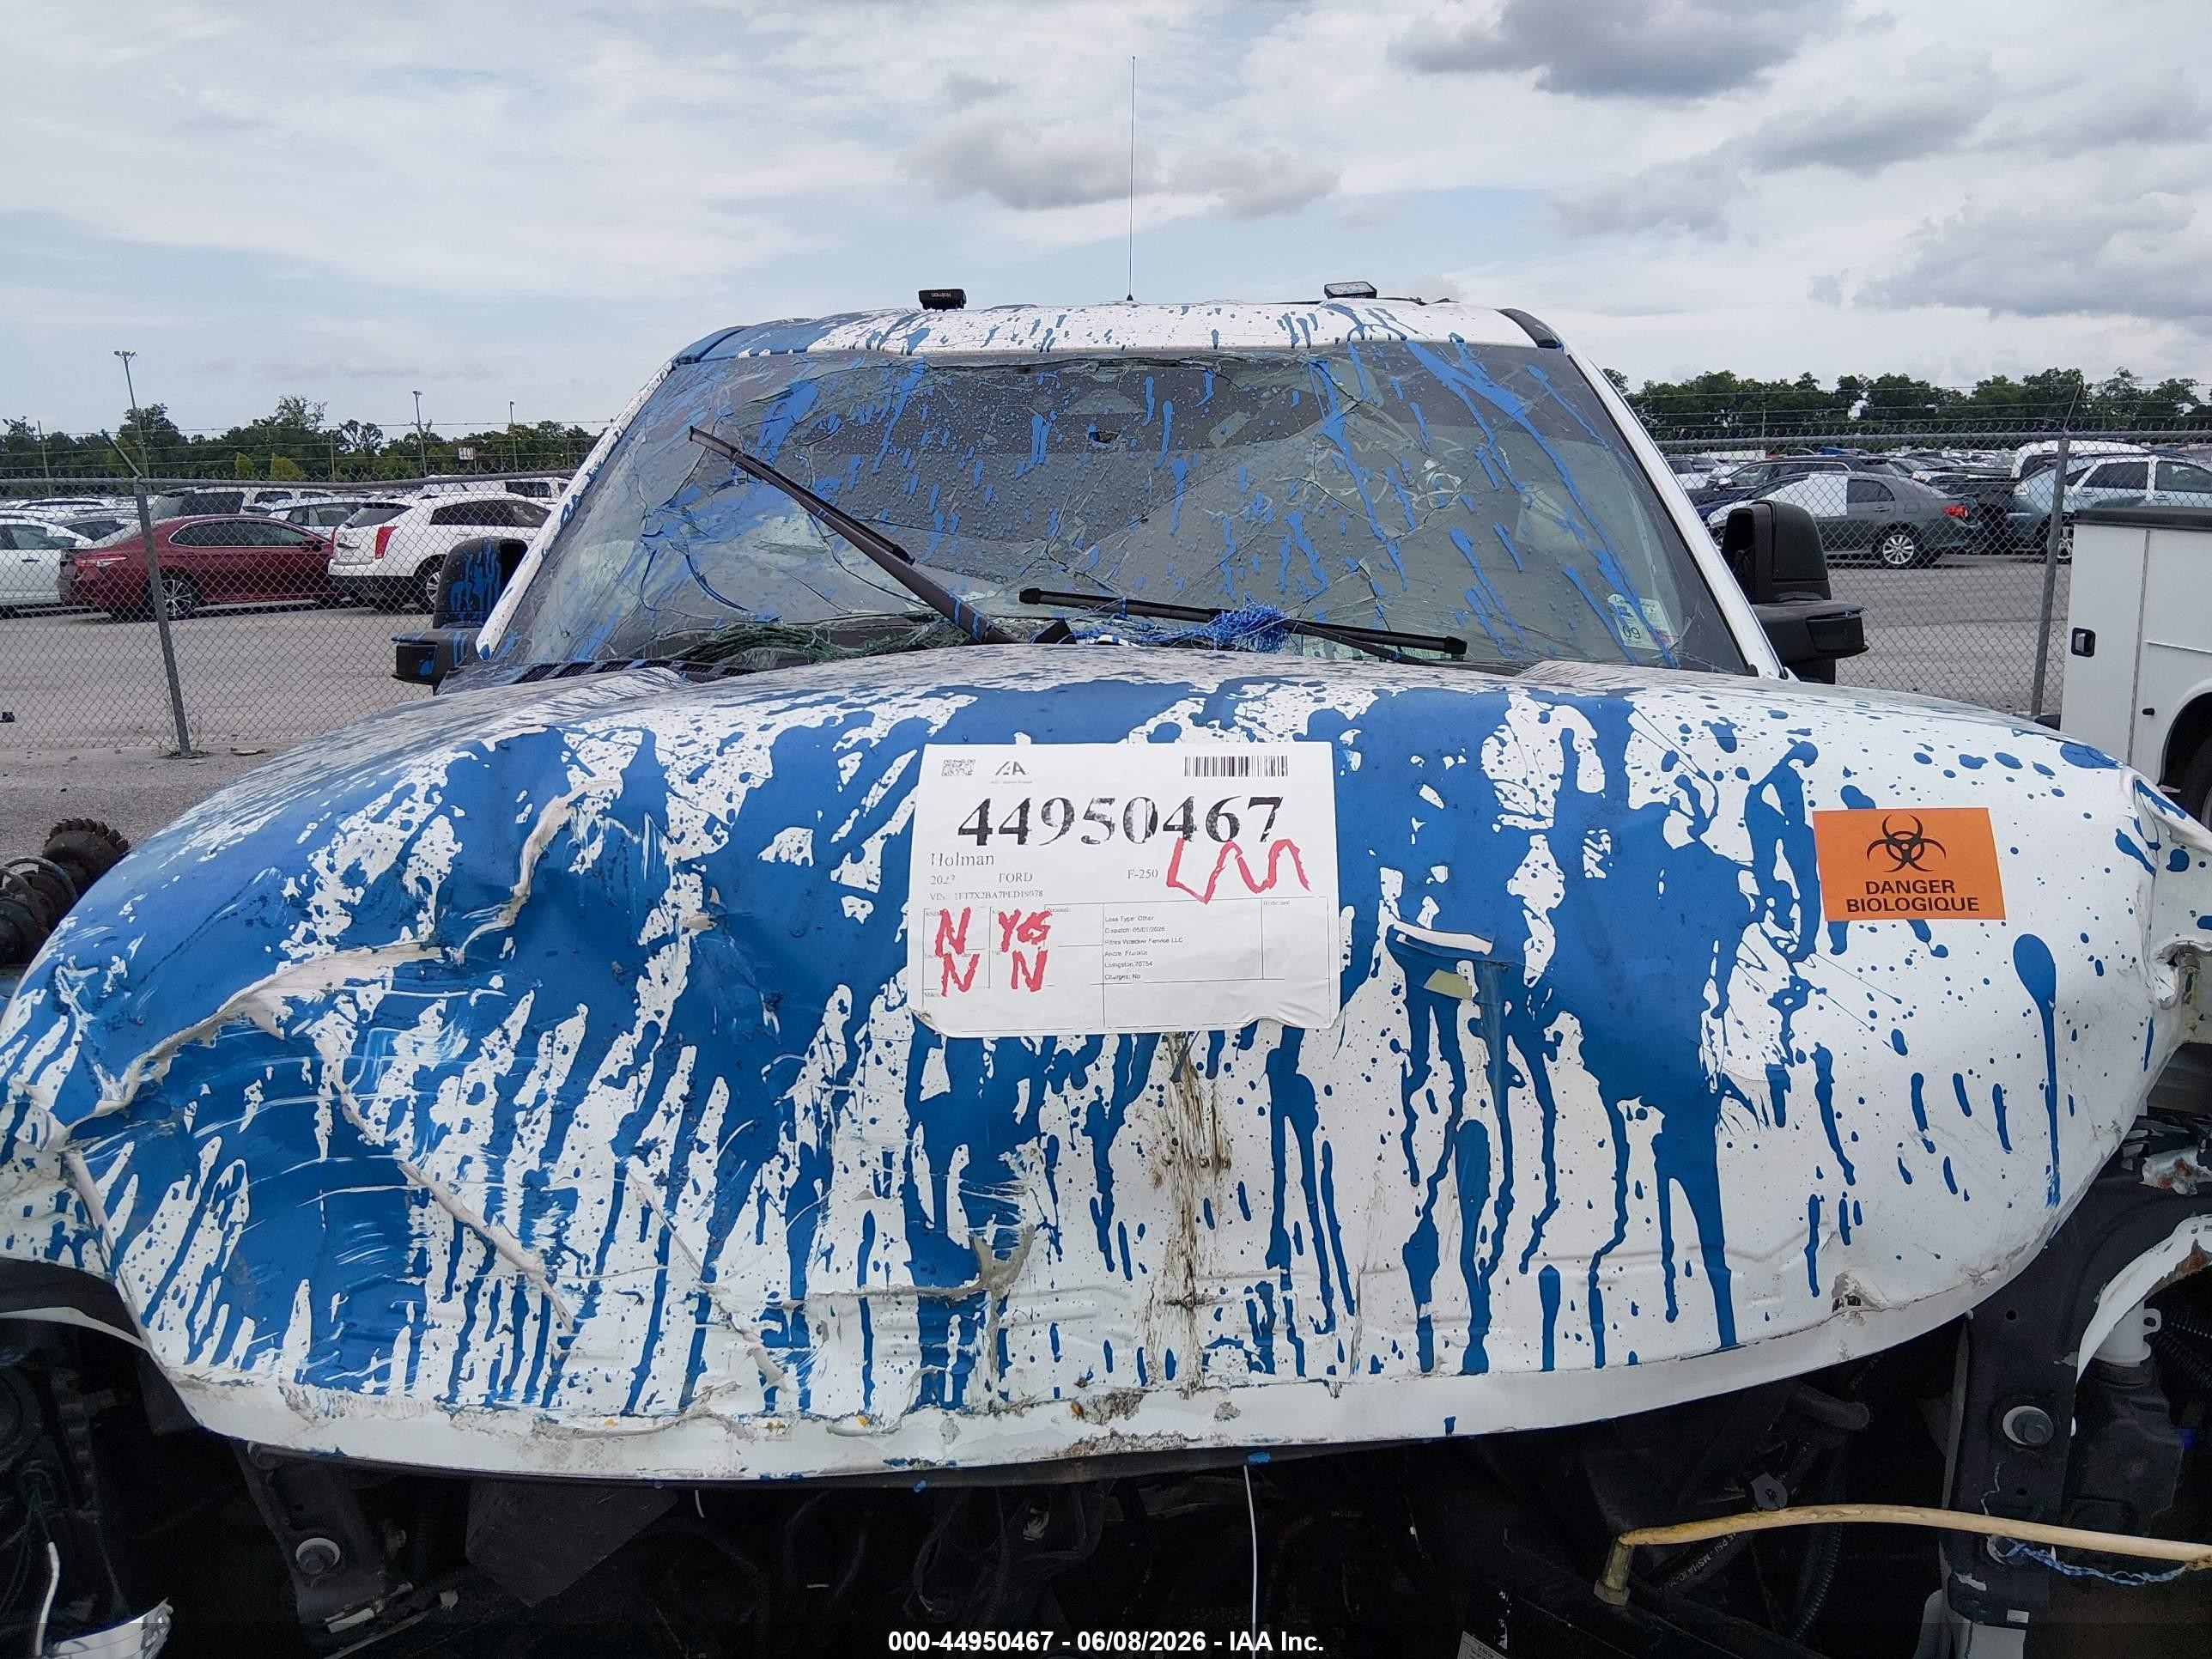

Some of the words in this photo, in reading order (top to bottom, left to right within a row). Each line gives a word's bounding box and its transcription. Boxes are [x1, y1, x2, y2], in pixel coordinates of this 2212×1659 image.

[957, 795, 1285, 847] 44950467
[929, 851, 995, 867] Holman
[999, 872, 1034, 884] FORD
[1127, 868, 1158, 879] F-250
[1865, 879, 1956, 895] DANGER
[1846, 896, 1980, 913] BIOLOGIQUE
[934, 906, 971, 958] N
[941, 952, 981, 998] N
[1010, 949, 1049, 993] N
